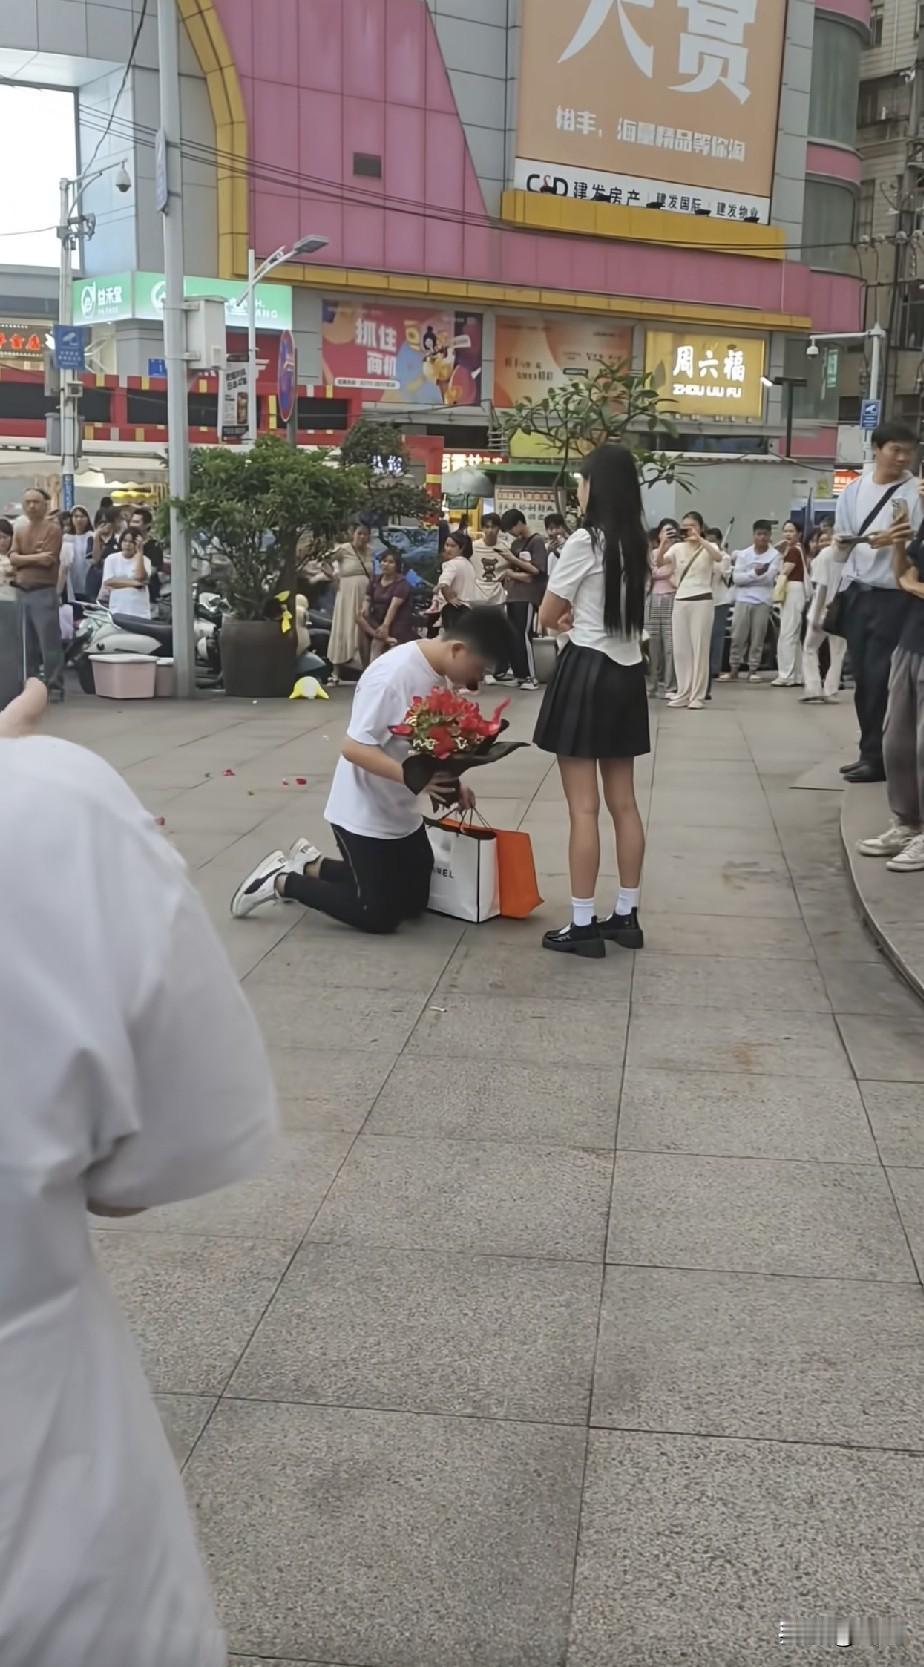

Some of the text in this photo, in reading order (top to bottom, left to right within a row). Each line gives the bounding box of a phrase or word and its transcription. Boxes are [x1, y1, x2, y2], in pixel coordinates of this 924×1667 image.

[355, 318, 396, 352] 抓住
[673, 345, 745, 382] 周六福
[672, 384, 742, 398] ZHOU LIU FU
